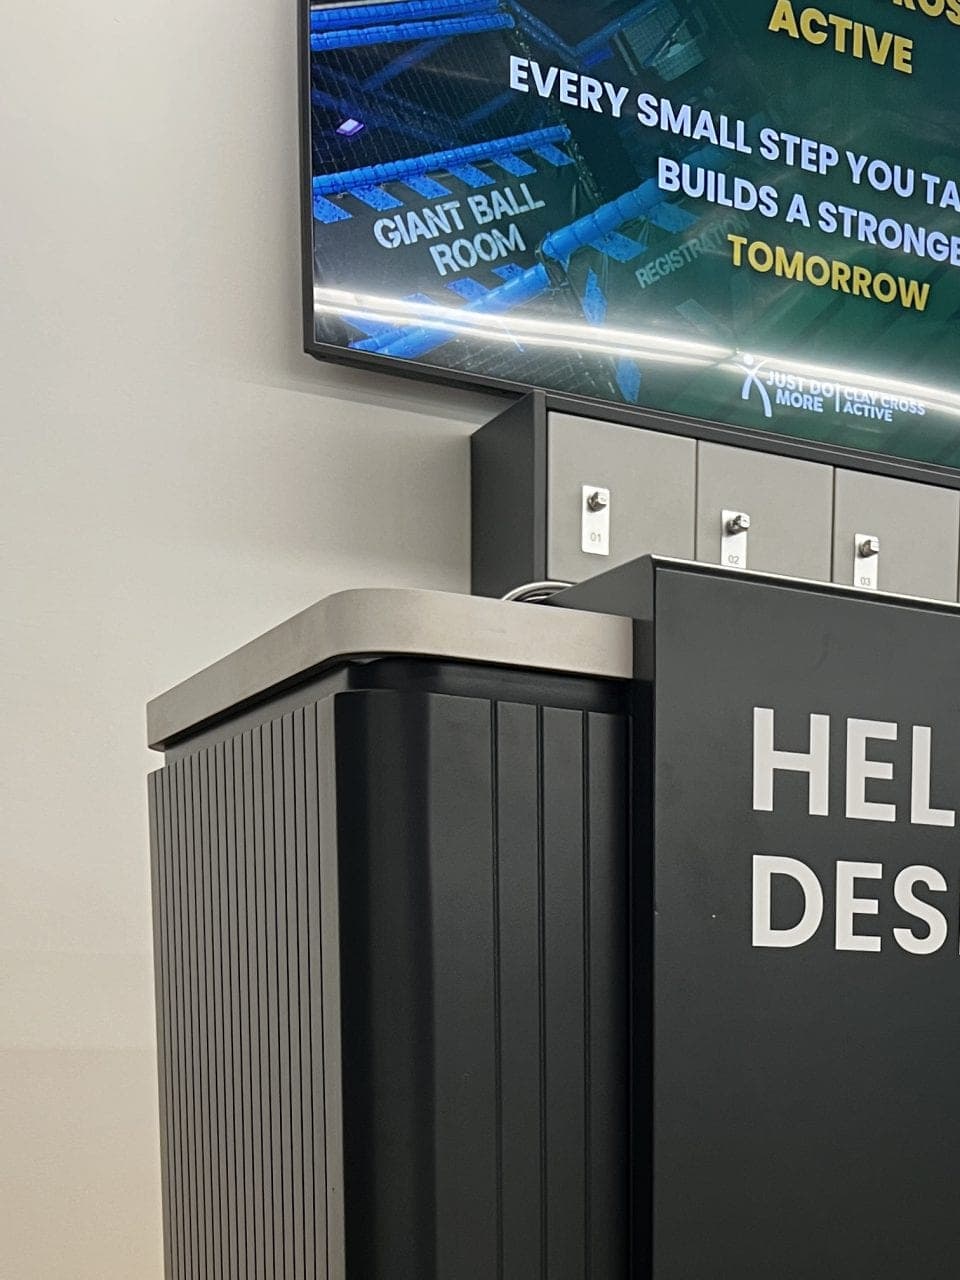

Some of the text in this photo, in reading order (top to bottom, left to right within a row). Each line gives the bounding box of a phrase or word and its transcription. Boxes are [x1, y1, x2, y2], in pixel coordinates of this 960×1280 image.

[768, 0, 914, 74] ACTIVE
[509, 55, 629, 118] EVERY
[637, 93, 753, 154] SMALL
[759, 127, 840, 175] STEP
[846, 150, 915, 198] YOU
[657, 156, 779, 218] BUILDS
[786, 193, 811, 228] A
[373, 183, 546, 249] GIANT BALL
[429, 223, 527, 276] ROOM
[727, 233, 930, 312] TOMORROW
[766, 371, 834, 399] JUST DO
[775, 389, 824, 413] MORE
[843, 389, 926, 416] CLAY CROSS
[843, 401, 893, 422] ACTIVE
[590, 532, 602, 543] 01
[727, 554, 740, 565] 02
[860, 577, 871, 587] 03
